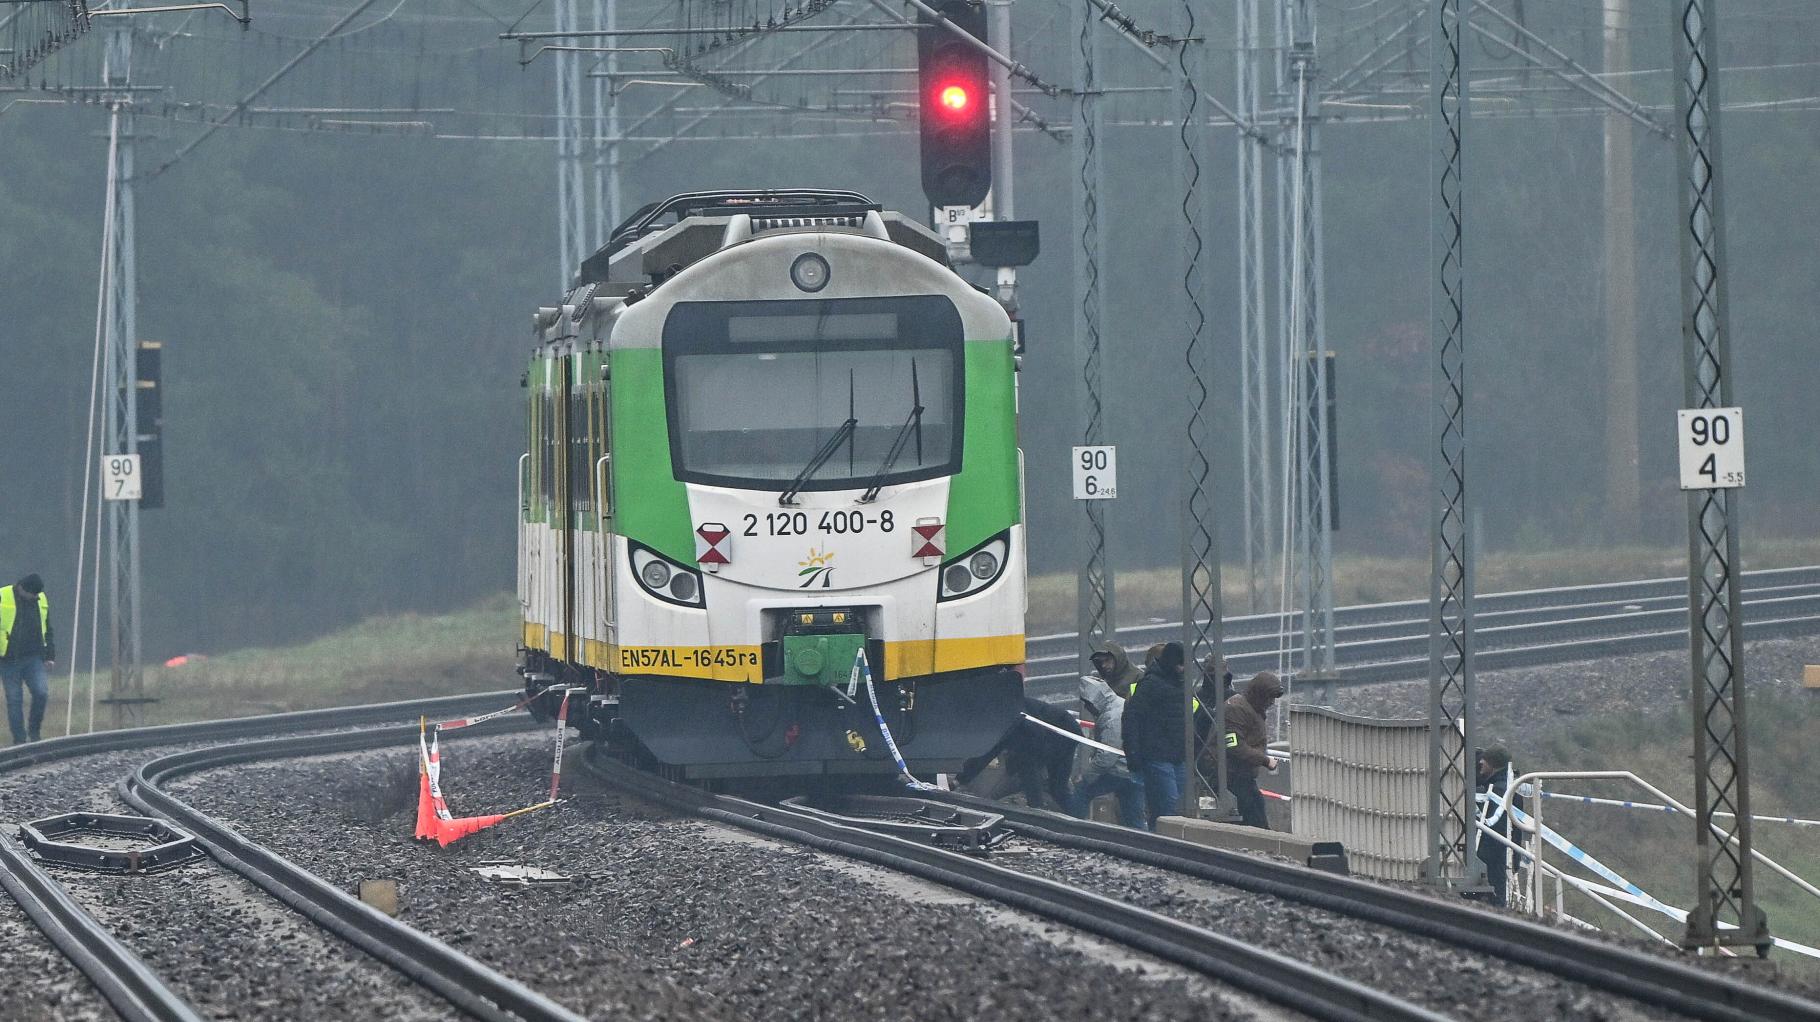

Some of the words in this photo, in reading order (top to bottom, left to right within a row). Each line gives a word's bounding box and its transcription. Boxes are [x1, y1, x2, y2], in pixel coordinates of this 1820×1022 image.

[1691, 415, 1730, 446] 90
[111, 458, 132, 476] 90
[1081, 450, 1107, 470] 90
[1699, 453, 1716, 483] 4
[114, 479, 125, 497] 7
[1085, 475, 1097, 495] 6
[743, 513, 758, 537] 2
[766, 511, 808, 536] 120
[818, 509, 895, 534] 400-8
